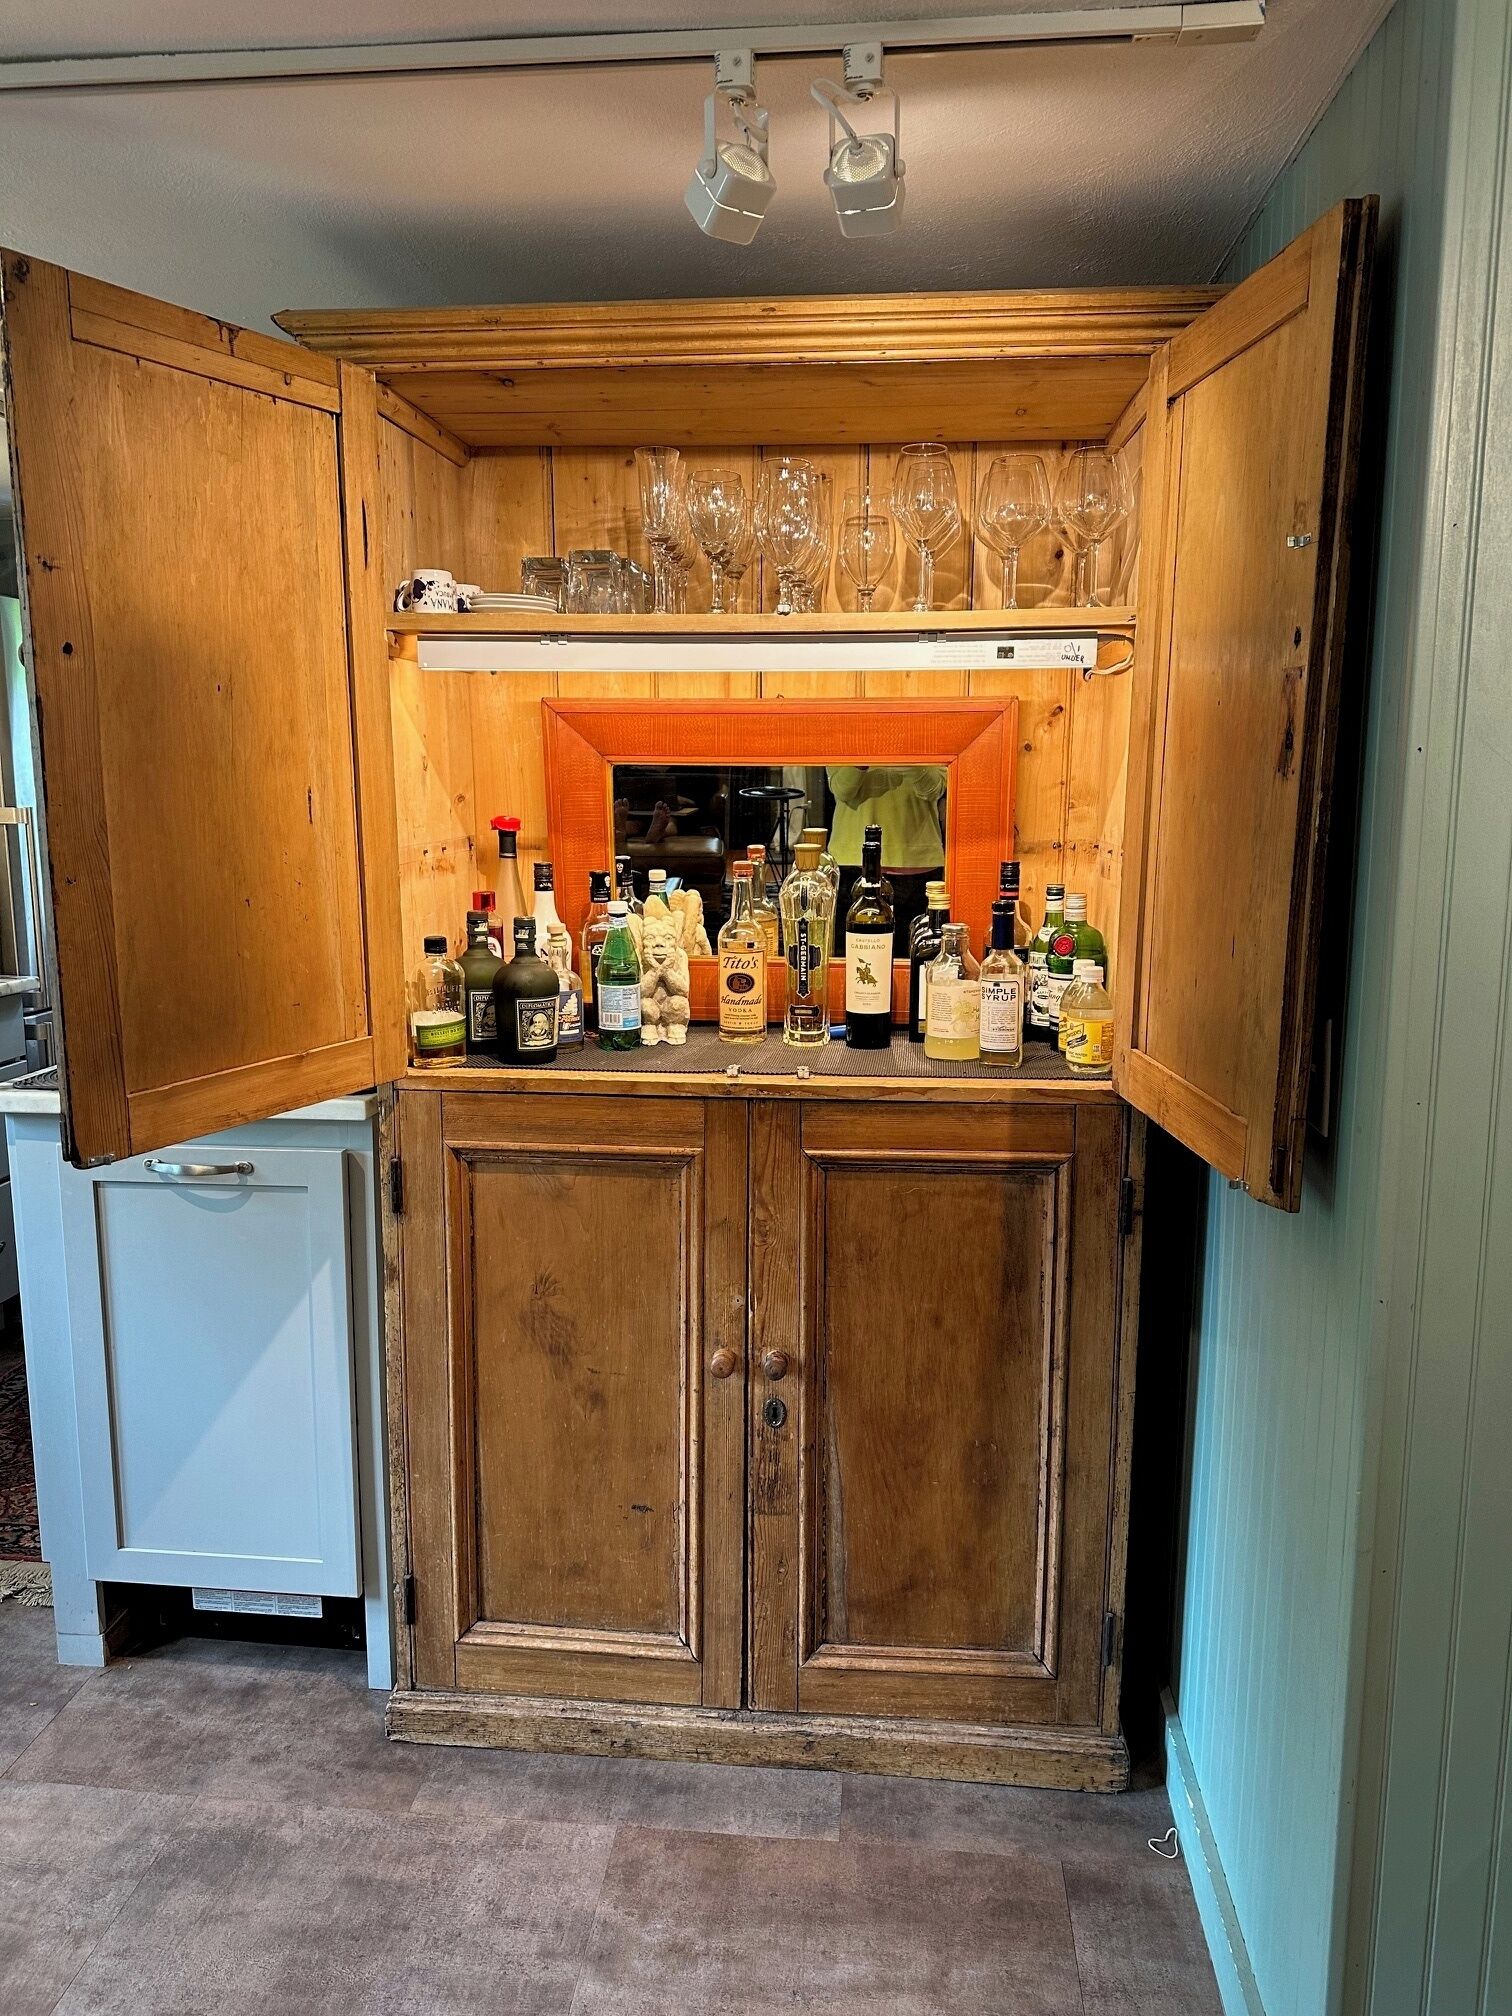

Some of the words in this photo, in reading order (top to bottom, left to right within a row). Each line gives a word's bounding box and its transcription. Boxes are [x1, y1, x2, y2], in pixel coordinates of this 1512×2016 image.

[1060, 653, 1085, 664] UNDER
[722, 955, 759, 970] Tito's
[981, 986, 1017, 995] SIMPLE
[720, 993, 763, 1006] Handmade
[981, 993, 1017, 1002] SYRUP
